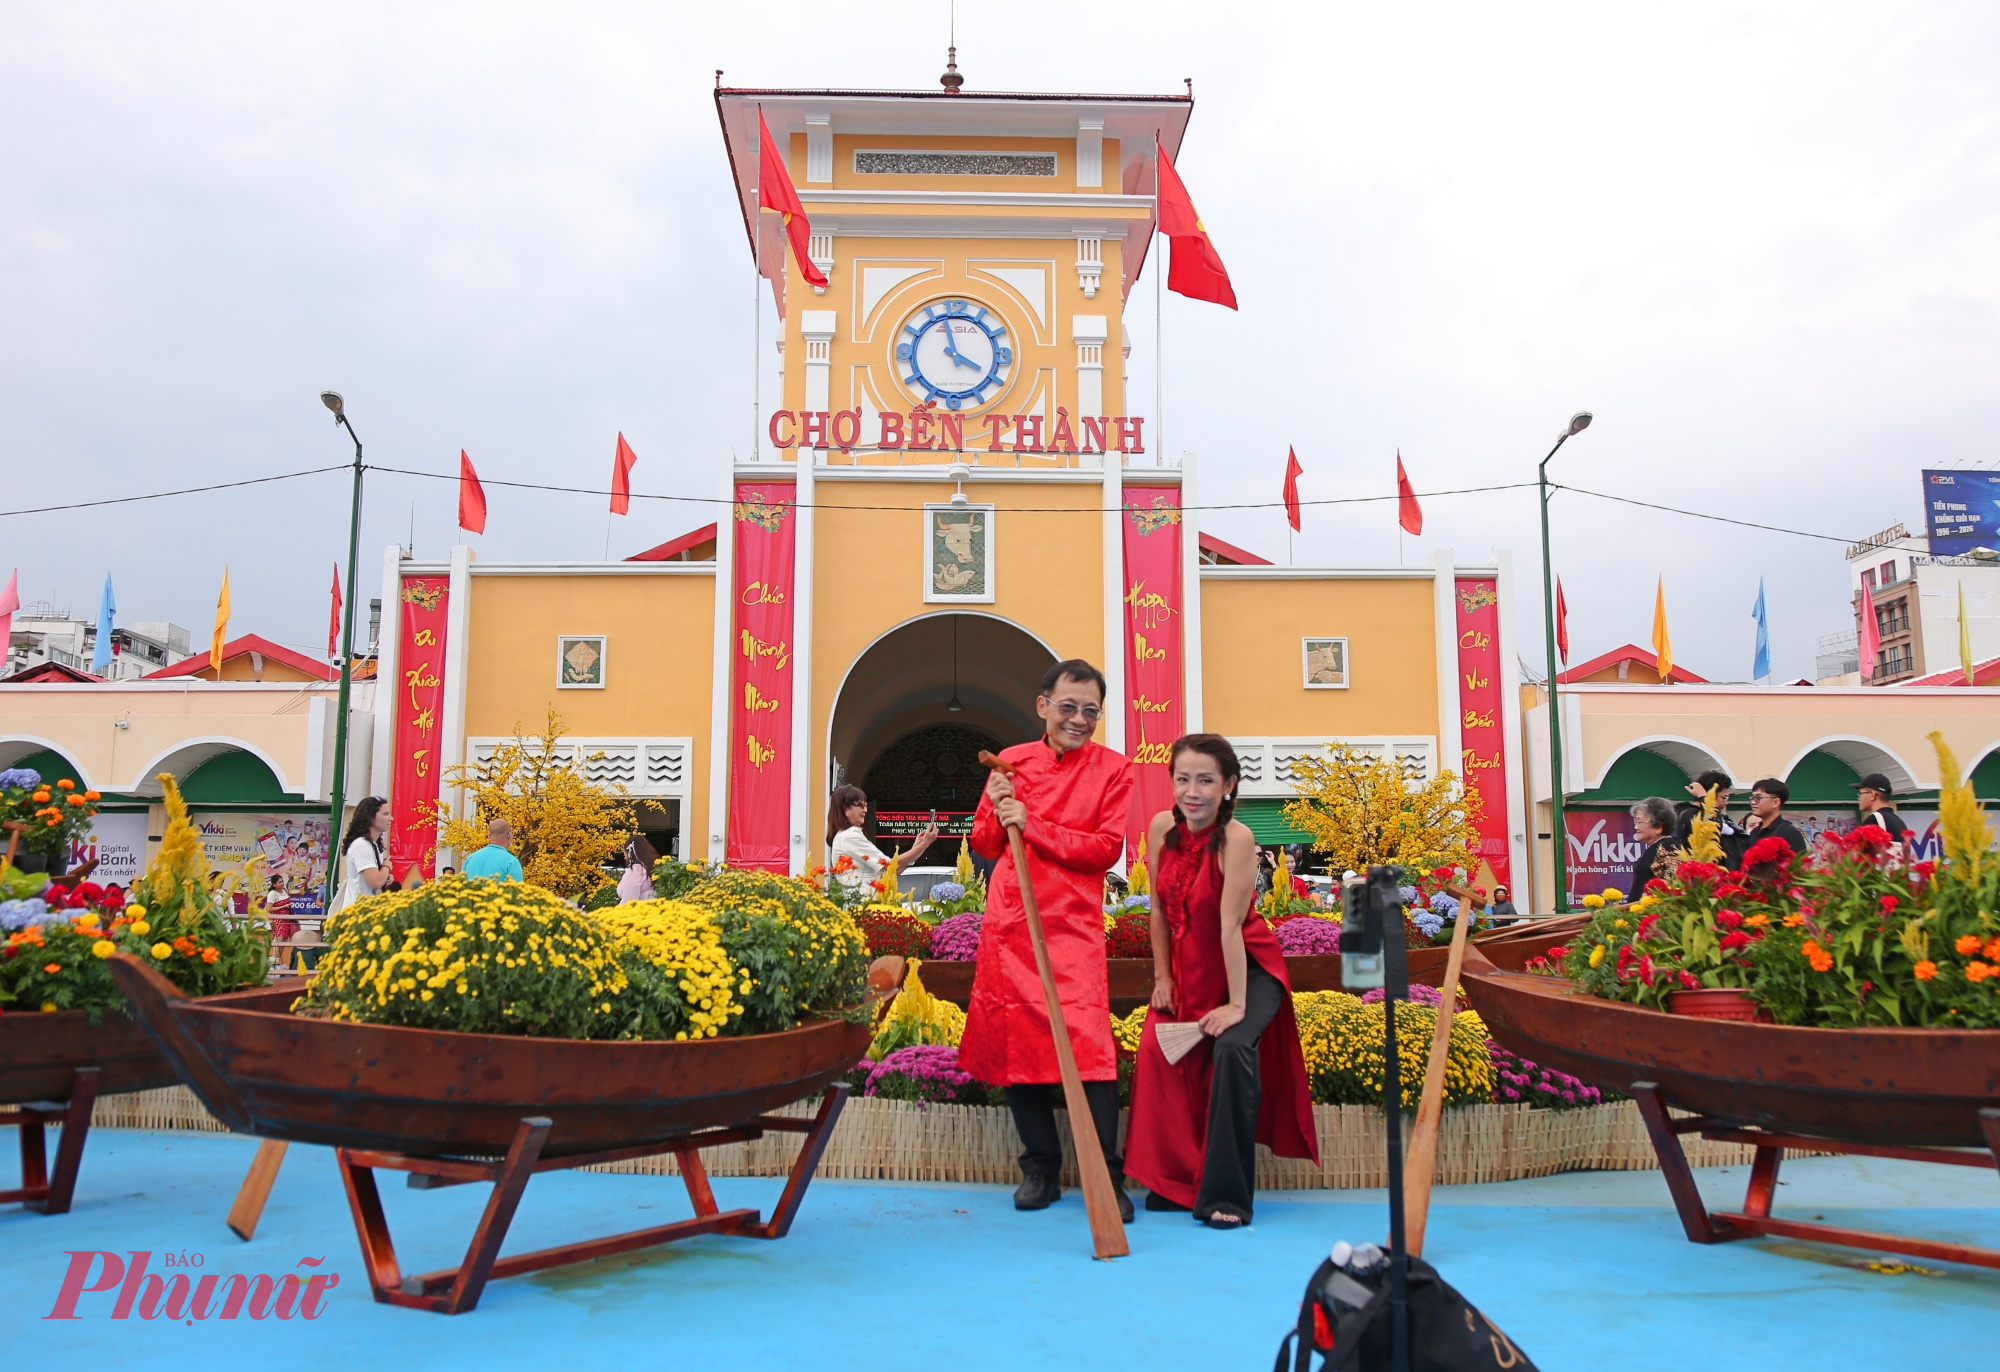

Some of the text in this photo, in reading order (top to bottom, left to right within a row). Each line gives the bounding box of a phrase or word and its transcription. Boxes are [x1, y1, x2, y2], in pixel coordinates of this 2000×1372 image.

[943, 300, 968, 317] 12
[896, 343, 912, 360] 9
[995, 347, 1012, 365] 3
[946, 393, 962, 410] 6
[769, 400, 1145, 455] CHỢ BẾN THÀNH
[1947, 503, 1967, 511] PHONG
[1935, 513, 1955, 523] KHÔNG
[1936, 528, 1950, 536] 1996
[1959, 525, 1974, 533] 2026
[742, 581, 786, 605] Chúc
[1124, 578, 1178, 629] Happy
[740, 629, 794, 671] Mừng
[1460, 630, 1491, 651] Chợ
[1465, 667, 1488, 690] Vui
[744, 682, 779, 716] Năm
[1463, 709, 1495, 730] Bến
[746, 735, 775, 773] Mới
[1133, 743, 1172, 764] 2026
[1462, 749, 1501, 775] Thành
[199, 820, 224, 834] Vikki
[101, 845, 129, 854] Digital
[1565, 819, 1641, 862] Vikki
[101, 854, 137, 865] Bank
[100, 868, 112, 876] Tốt
[115, 868, 136, 876] nhất!
[1566, 866, 1586, 874] Ngân
[1588, 866, 1608, 874] hàng
[1609, 865, 1625, 873] Tiết
